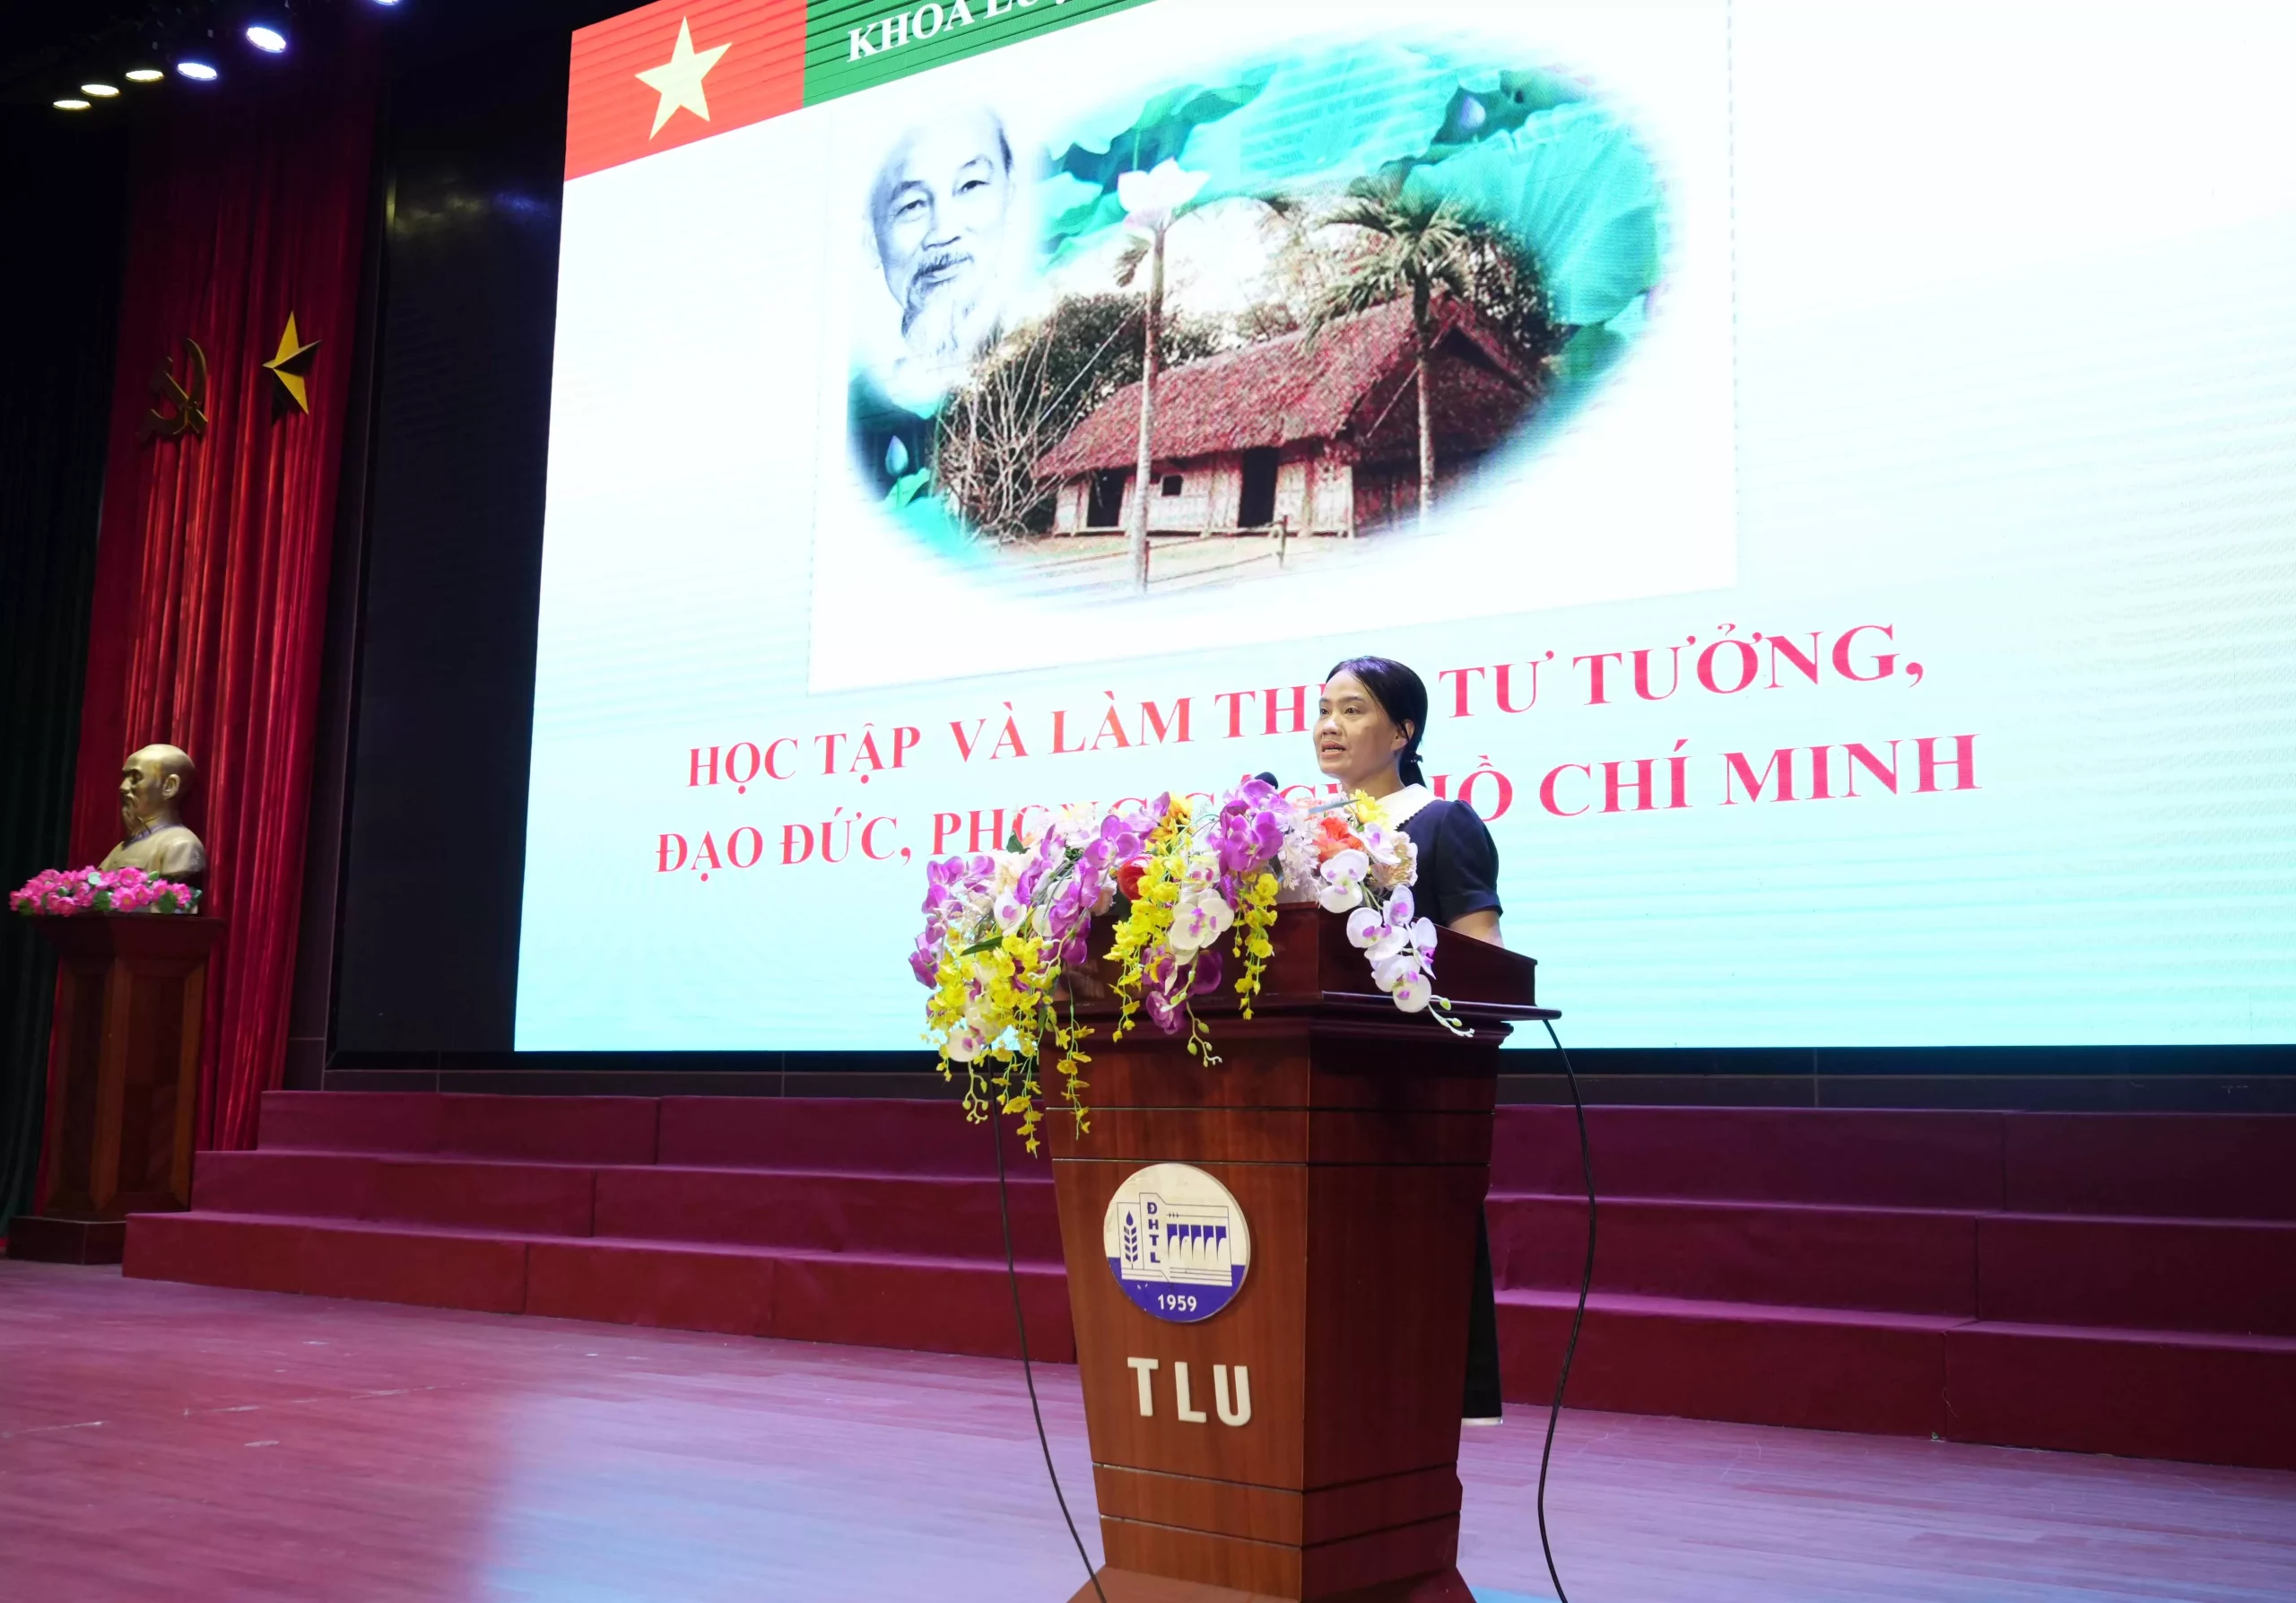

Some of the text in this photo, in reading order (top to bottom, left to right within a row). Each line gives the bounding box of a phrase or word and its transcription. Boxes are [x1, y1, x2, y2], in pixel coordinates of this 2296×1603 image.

[846, 1, 975, 63] KHOA
[687, 622, 1925, 795] HỌC TẬP VÀ LÀM TH TƯ TƯỞNG,
[657, 825, 763, 883] ĐẠO
[780, 806, 911, 866] ĐỨC,
[1538, 737, 1692, 818] CHÍ
[1721, 733, 1980, 806] MINH
[1157, 1294, 1197, 1313] 1959
[1126, 1356, 1252, 1427] TLU
